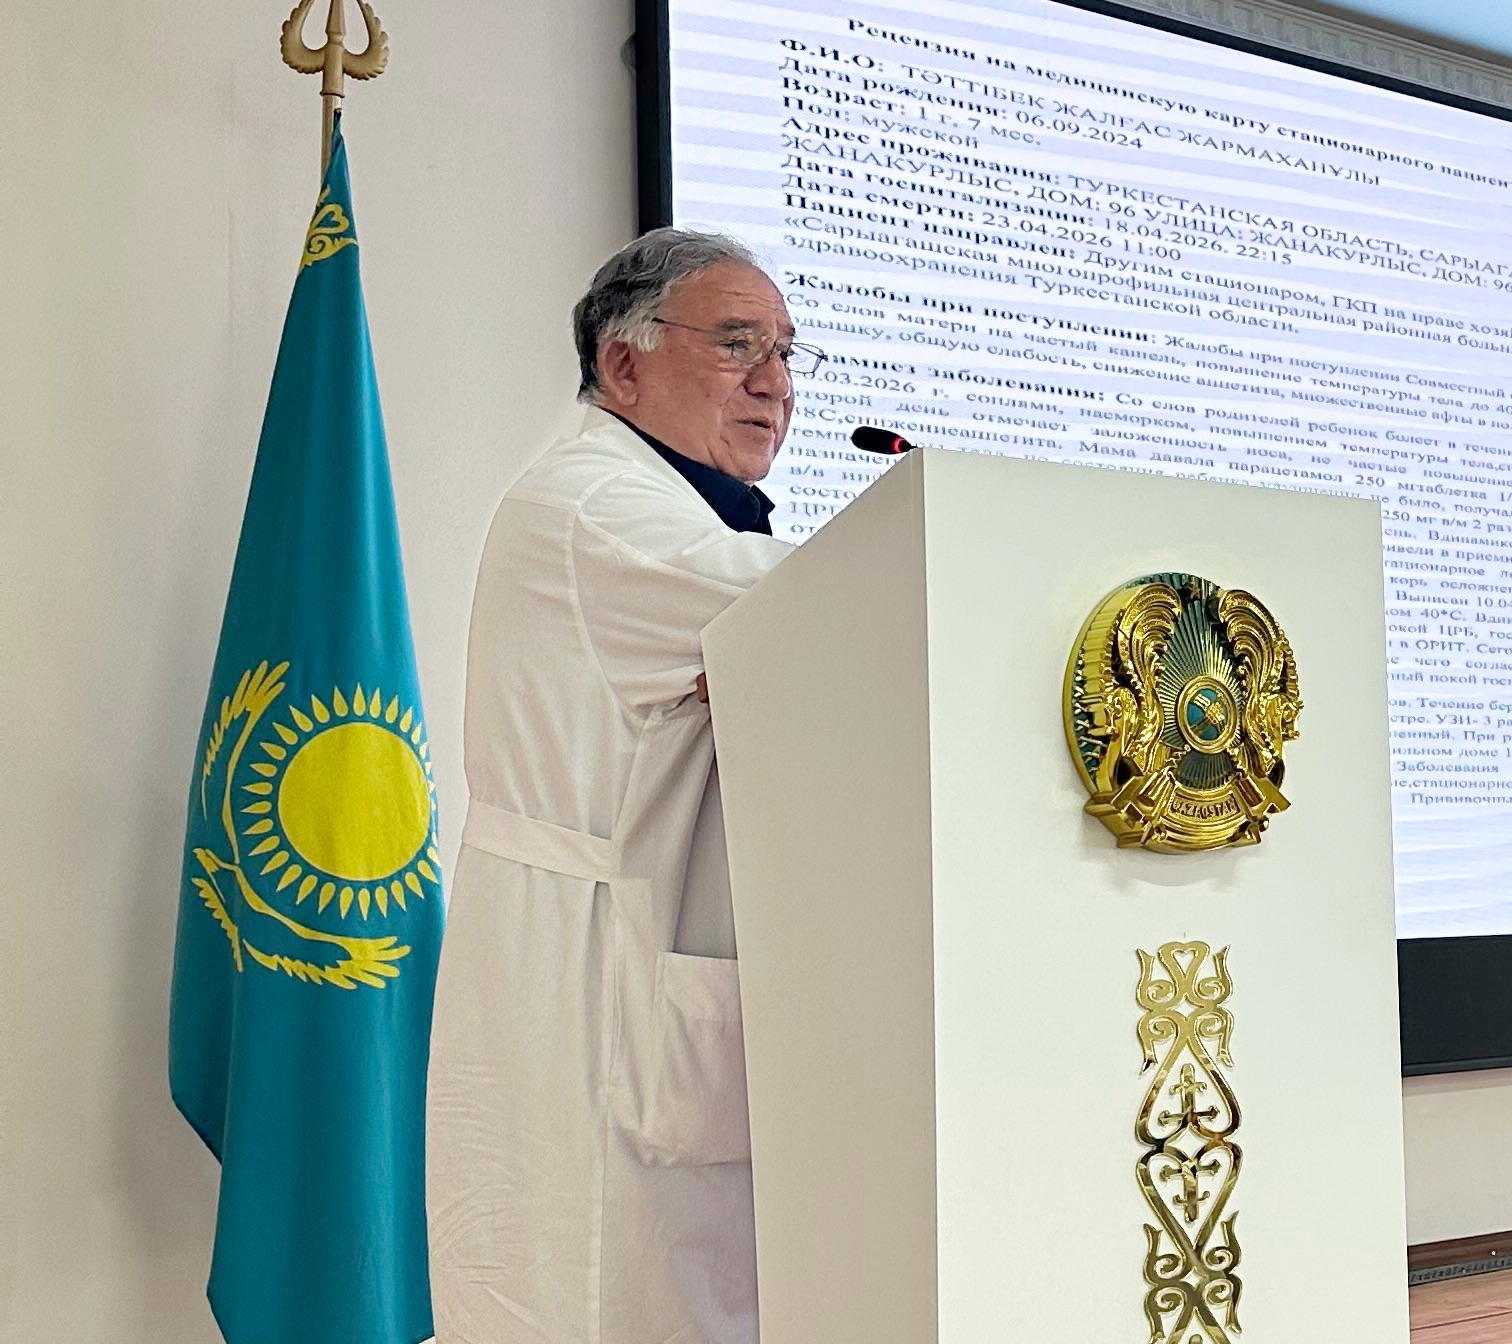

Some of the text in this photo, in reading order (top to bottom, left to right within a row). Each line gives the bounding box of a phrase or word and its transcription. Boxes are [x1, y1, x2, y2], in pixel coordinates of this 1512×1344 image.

[779, 39, 884, 71] Ф.И.О:
[848, 19, 976, 62] Рецензия
[986, 56, 1017, 72] на
[1025, 66, 1198, 115] медицинскую
[1204, 109, 1271, 134] карту
[1276, 127, 1435, 172] стационарного
[778, 57, 1143, 149] Дата рождения: 06.09.2024
[782, 76, 906, 114] Возраст:
[939, 114, 959, 128] г.
[991, 125, 1041, 146] мес.
[782, 96, 979, 150] Пол: мужской
[780, 154, 855, 180] Дата
[865, 173, 1094, 226] госпитализации:
[1236, 244, 1292, 265] 22:15
[781, 117, 871, 145] Адрес
[879, 138, 1060, 184] проживания:
[1067, 174, 1294, 233] ТУРКЕСТАНСКАЯ
[1301, 224, 1414, 259] ОБЛАСТЬ,
[781, 174, 1183, 261] Дата смерти: 23.04.2026 11:00
[784, 192, 914, 230] Пациент
[923, 223, 1076, 260] направлен:
[1083, 250, 1174, 278] Другим
[1180, 271, 1326, 307] стационаром,
[1332, 295, 1378, 315] ГКП
[1384, 307, 1407, 320] на
[1412, 312, 1465, 331] праве
[784, 216, 999, 264] «Сарыагашская
[1007, 256, 1221, 304] многопрофильная
[1227, 295, 1357, 328] центральная
[1362, 320, 1452, 344] районная
[1026, 185, 1101, 211] ДОМ:
[1108, 201, 1136, 218] 96
[1143, 208, 1243, 240] УЛИЦА:
[1431, 266, 1487, 288] ДОМ:
[784, 234, 1299, 334] здравоохранения Туркестанской области.
[784, 271, 911, 304] Жалобы
[921, 298, 973, 314] при
[983, 308, 1157, 344] поступлении:
[1164, 334, 1244, 358] Жалобы
[1249, 351, 1284, 365] при
[1289, 357, 1401, 383] поступлении
[1405, 374, 1506, 400] Совместный
[786, 293, 820, 309] Со
[831, 303, 886, 320] слов
[897, 313, 977, 334] матери
[988, 327, 1014, 339] на
[1023, 333, 1098, 352] частый
[1108, 346, 1187, 368] кашель,
[1195, 360, 1303, 384] повышение
[1310, 378, 1421, 402] температуры
[1428, 396, 1464, 408] тела
[1469, 402, 1490, 412] до
[898, 331, 981, 353] общую
[986, 346, 1087, 370] слабость,
[1092, 361, 1192, 385] снижение
[1291, 390, 1428, 419] множественные
[895, 402, 950, 418] день
[972, 412, 1070, 433] отмечает
[1090, 428, 1228, 453] заложенность
[1246, 447, 1294, 462] носа,
[1348, 459, 1408, 476] частые
[927, 369, 1105, 402] заболевания:
[1115, 392, 1144, 407] Со
[1151, 400, 1197, 414] слов
[1204, 408, 1300, 429] родителей
[1307, 422, 1379, 440] ребенок
[1385, 430, 1439, 448] болеет
[932, 388, 950, 399] г.
[965, 393, 1065, 415] соплями,
[1079, 408, 1196, 433] насморком,
[1209, 425, 1328, 448] повышением
[1339, 443, 1449, 464] температуры
[1079, 440, 1137, 459] Мама
[1149, 452, 1215, 468] давала
[1228, 461, 1343, 483] парацетамол
[1355, 474, 1386, 489] 250
[1398, 495, 1446, 512] было,
